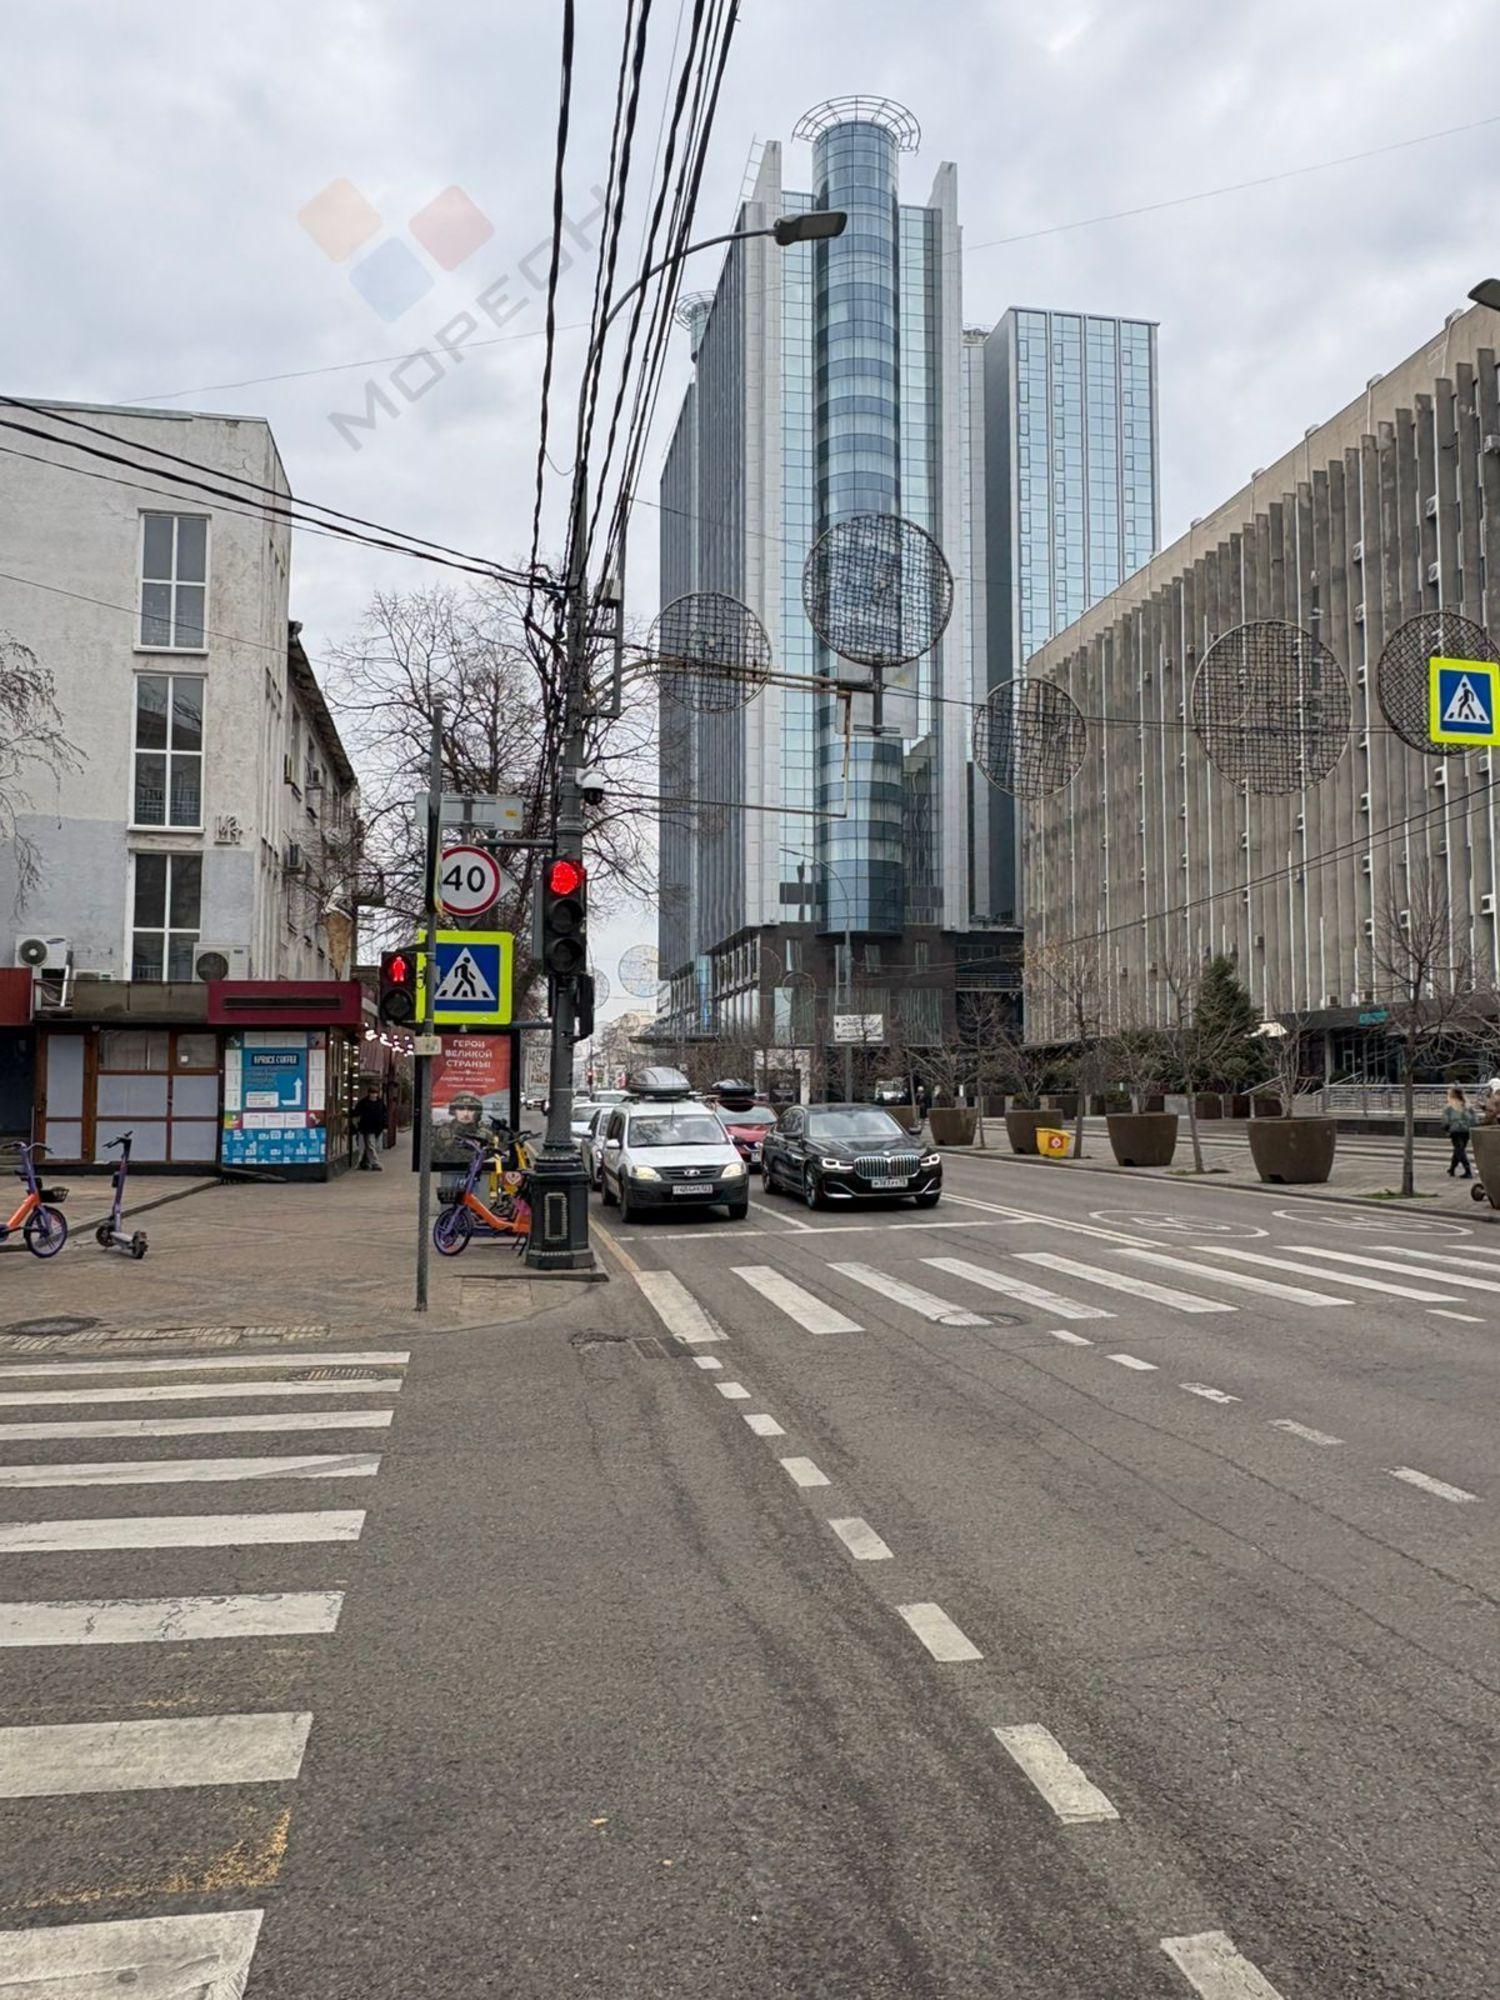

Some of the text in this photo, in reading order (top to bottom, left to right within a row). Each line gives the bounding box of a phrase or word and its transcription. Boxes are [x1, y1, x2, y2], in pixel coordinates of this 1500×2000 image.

[442, 864, 487, 893] 40
[453, 1039, 486, 1048] ГЕРОИ
[445, 1048, 493, 1058] ВЕЛИКОЙ
[446, 1059, 491, 1068] СТРАНЫ
